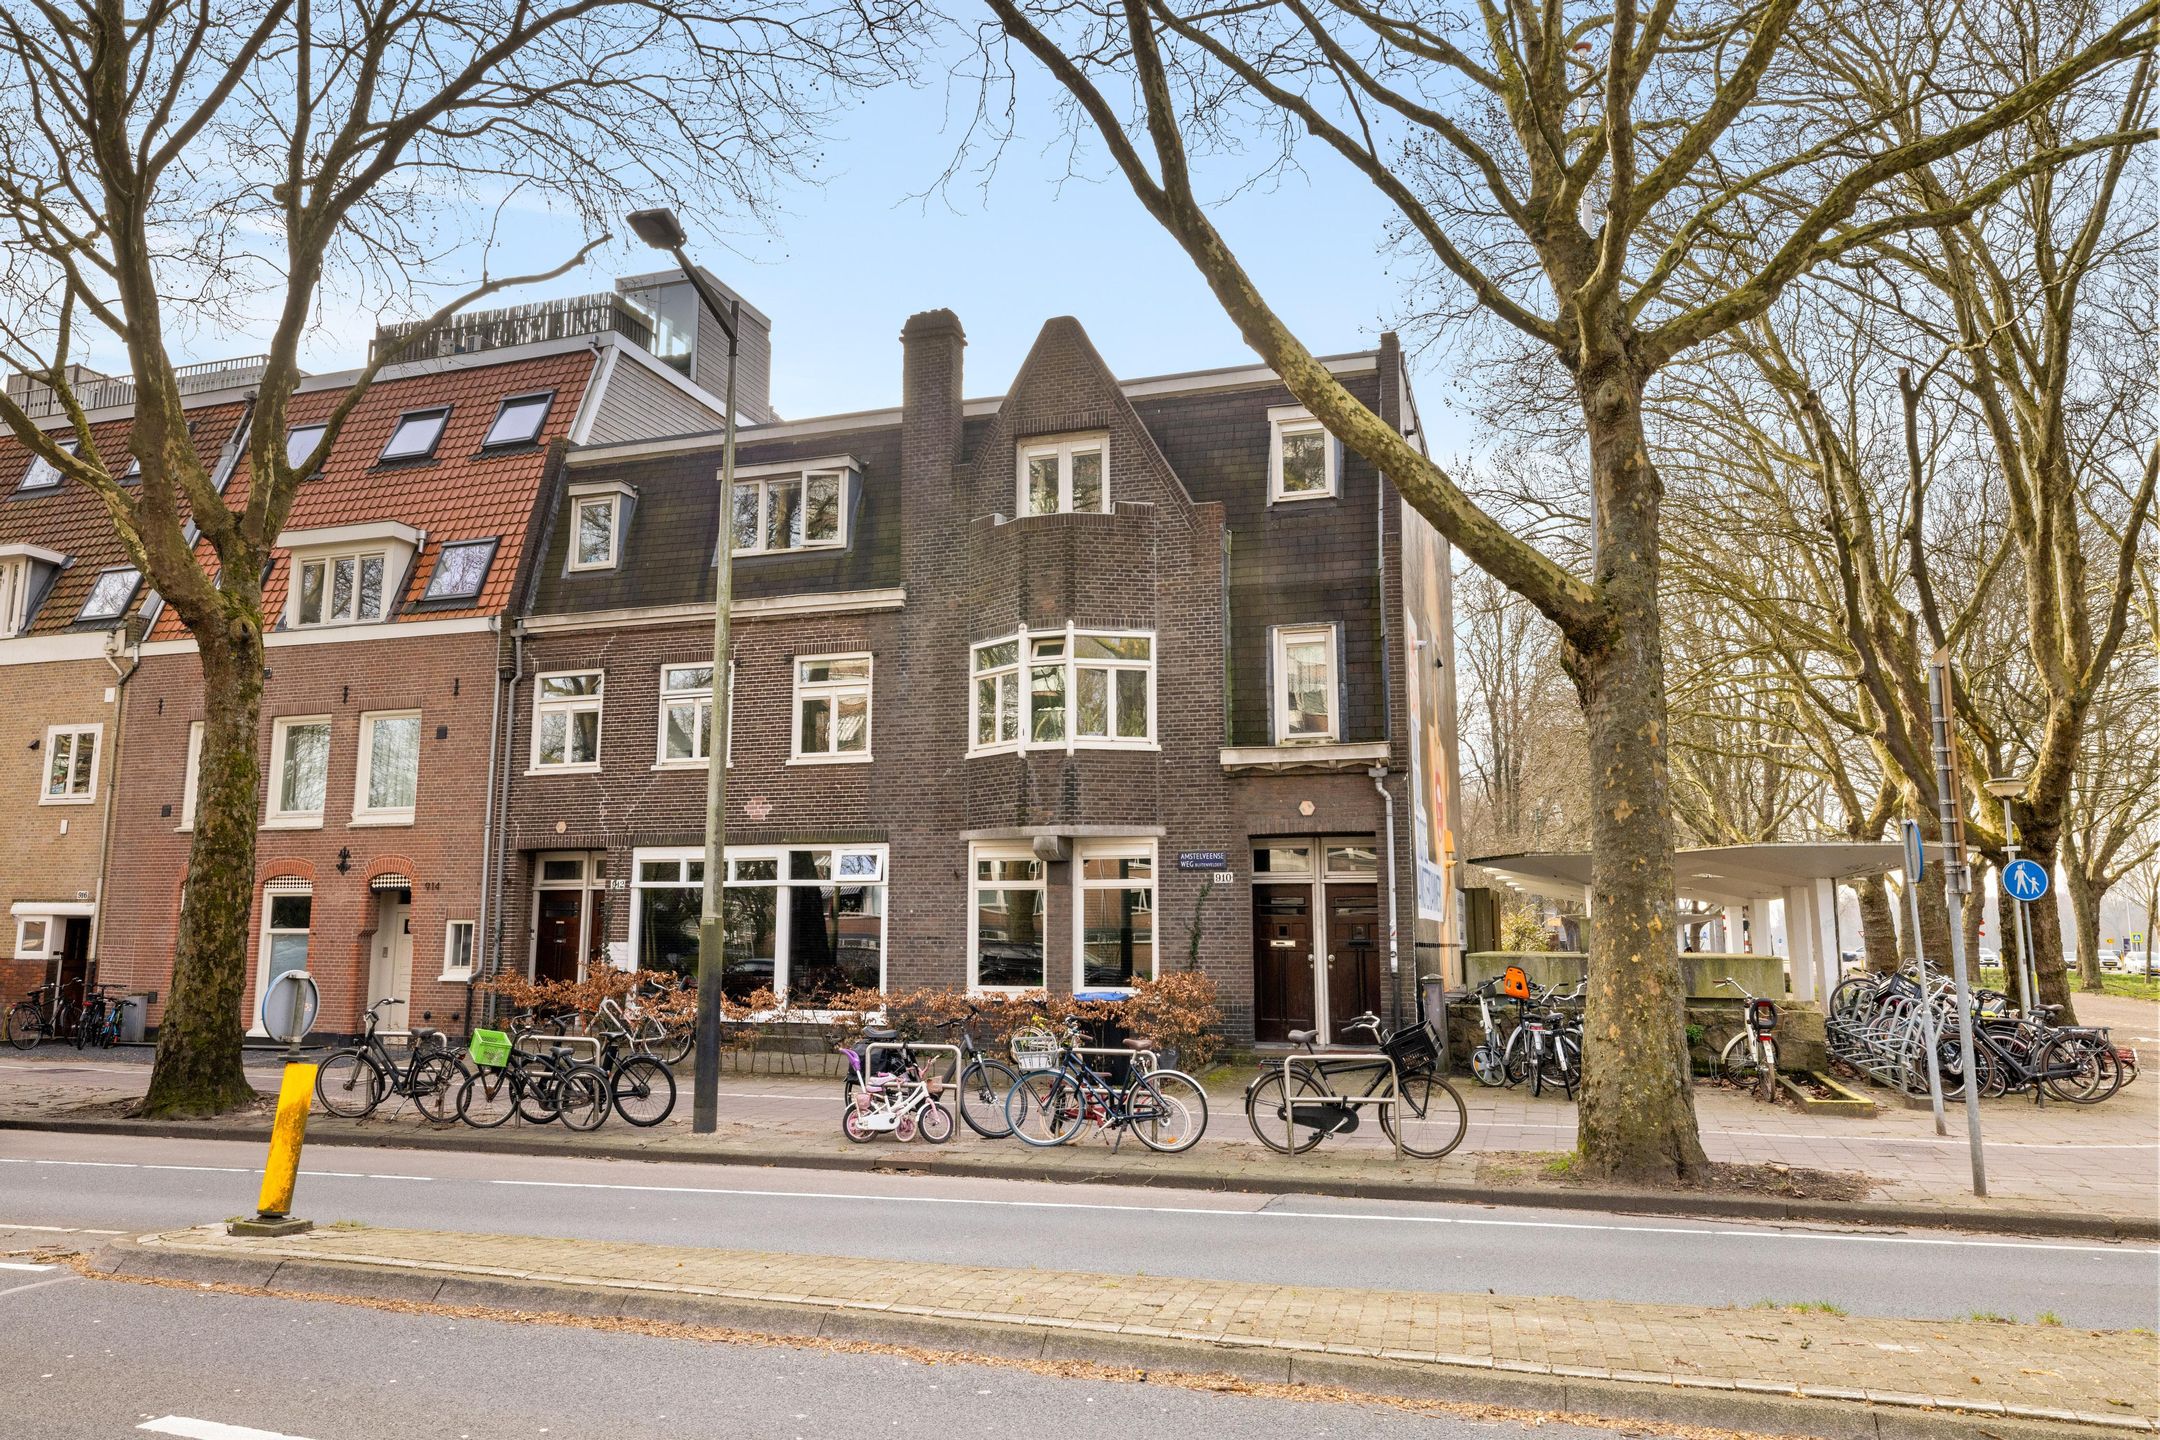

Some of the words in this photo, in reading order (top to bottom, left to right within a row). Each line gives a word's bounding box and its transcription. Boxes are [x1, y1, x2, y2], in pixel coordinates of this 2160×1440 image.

[1181, 852, 1224, 860] AMSTELVEENSE
[1215, 873, 1232, 882] 910
[425, 882, 440, 891] 914
